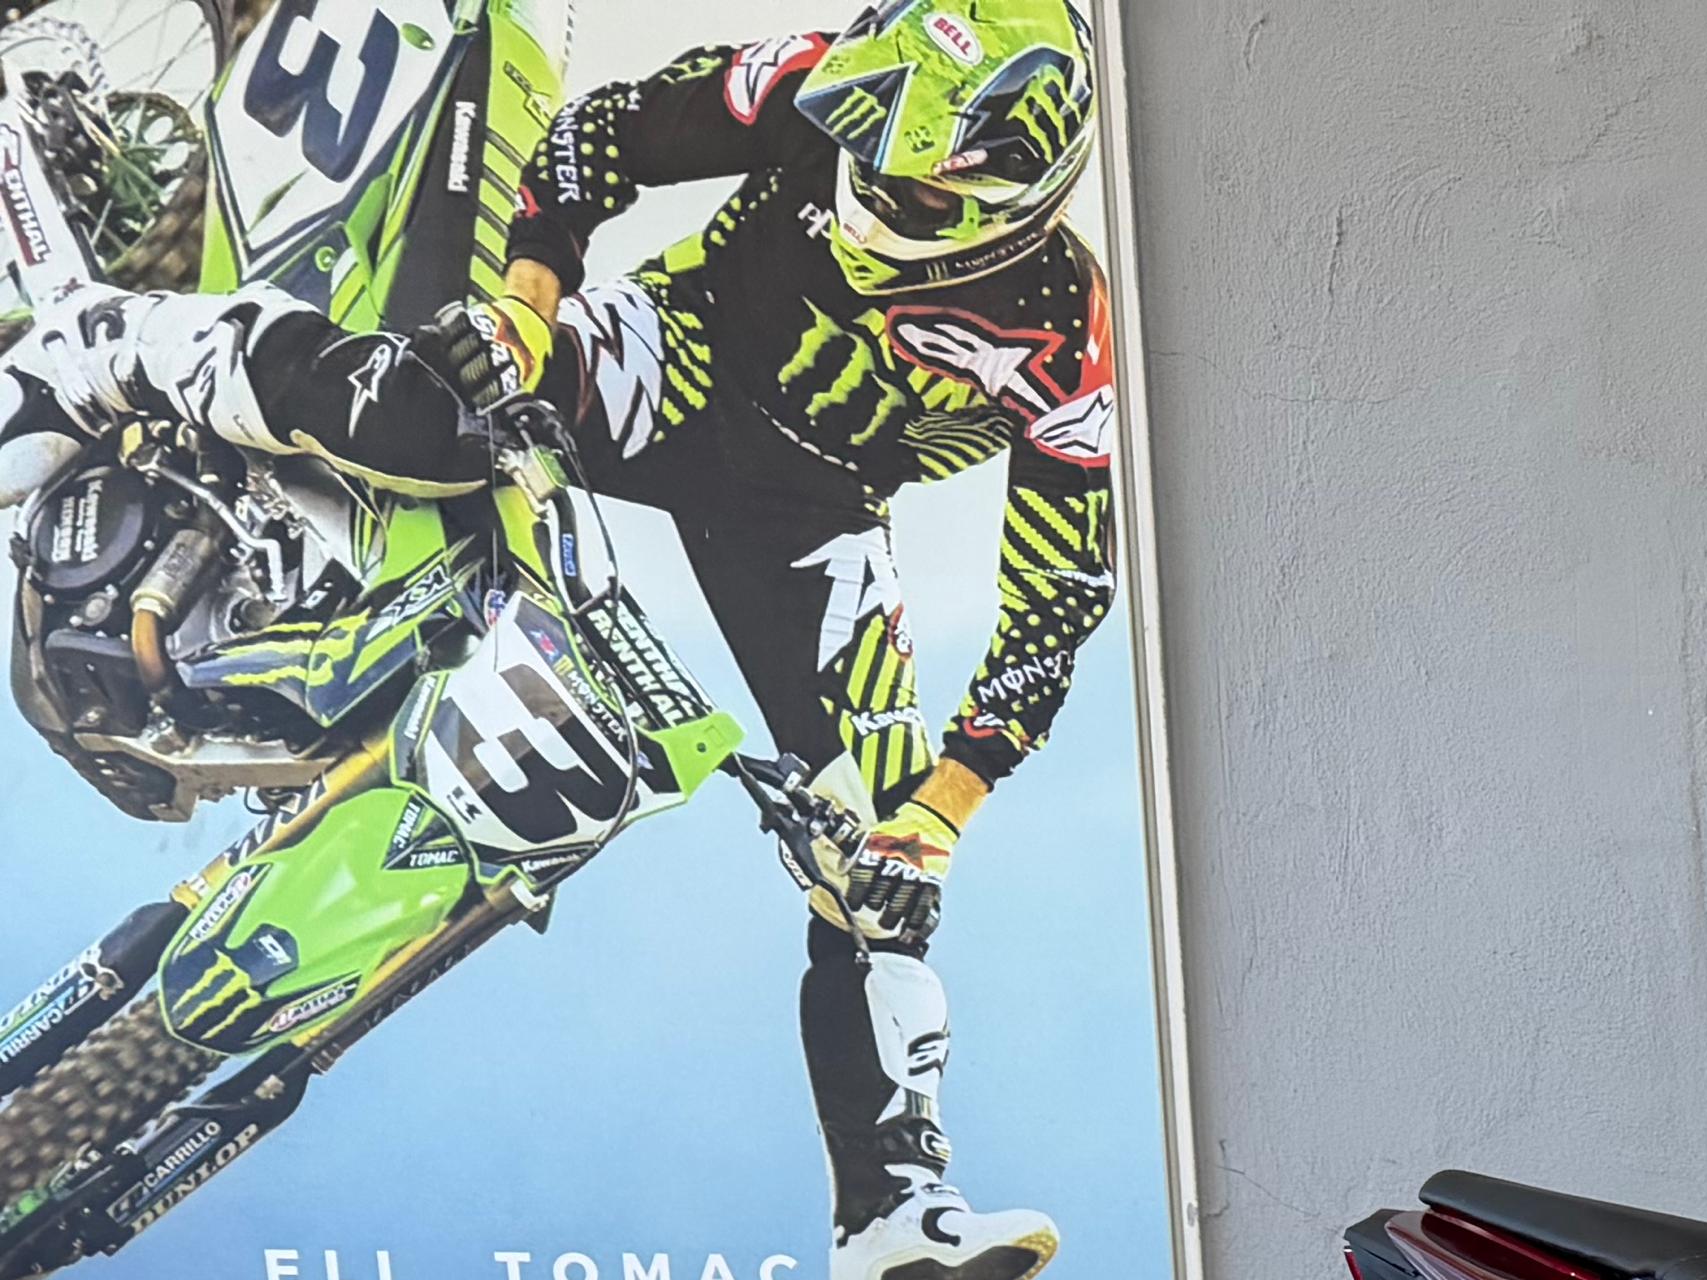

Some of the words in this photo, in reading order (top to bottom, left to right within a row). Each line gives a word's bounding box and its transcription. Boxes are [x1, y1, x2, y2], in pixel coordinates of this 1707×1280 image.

[932, 16, 973, 57] BELL
[430, 663, 641, 845] 3
[392, 800, 421, 848] TOMAC
[410, 850, 459, 868] TOMAC
[131, 1123, 259, 1233] DUNLOP
[144, 1119, 223, 1188] CARRILLO
